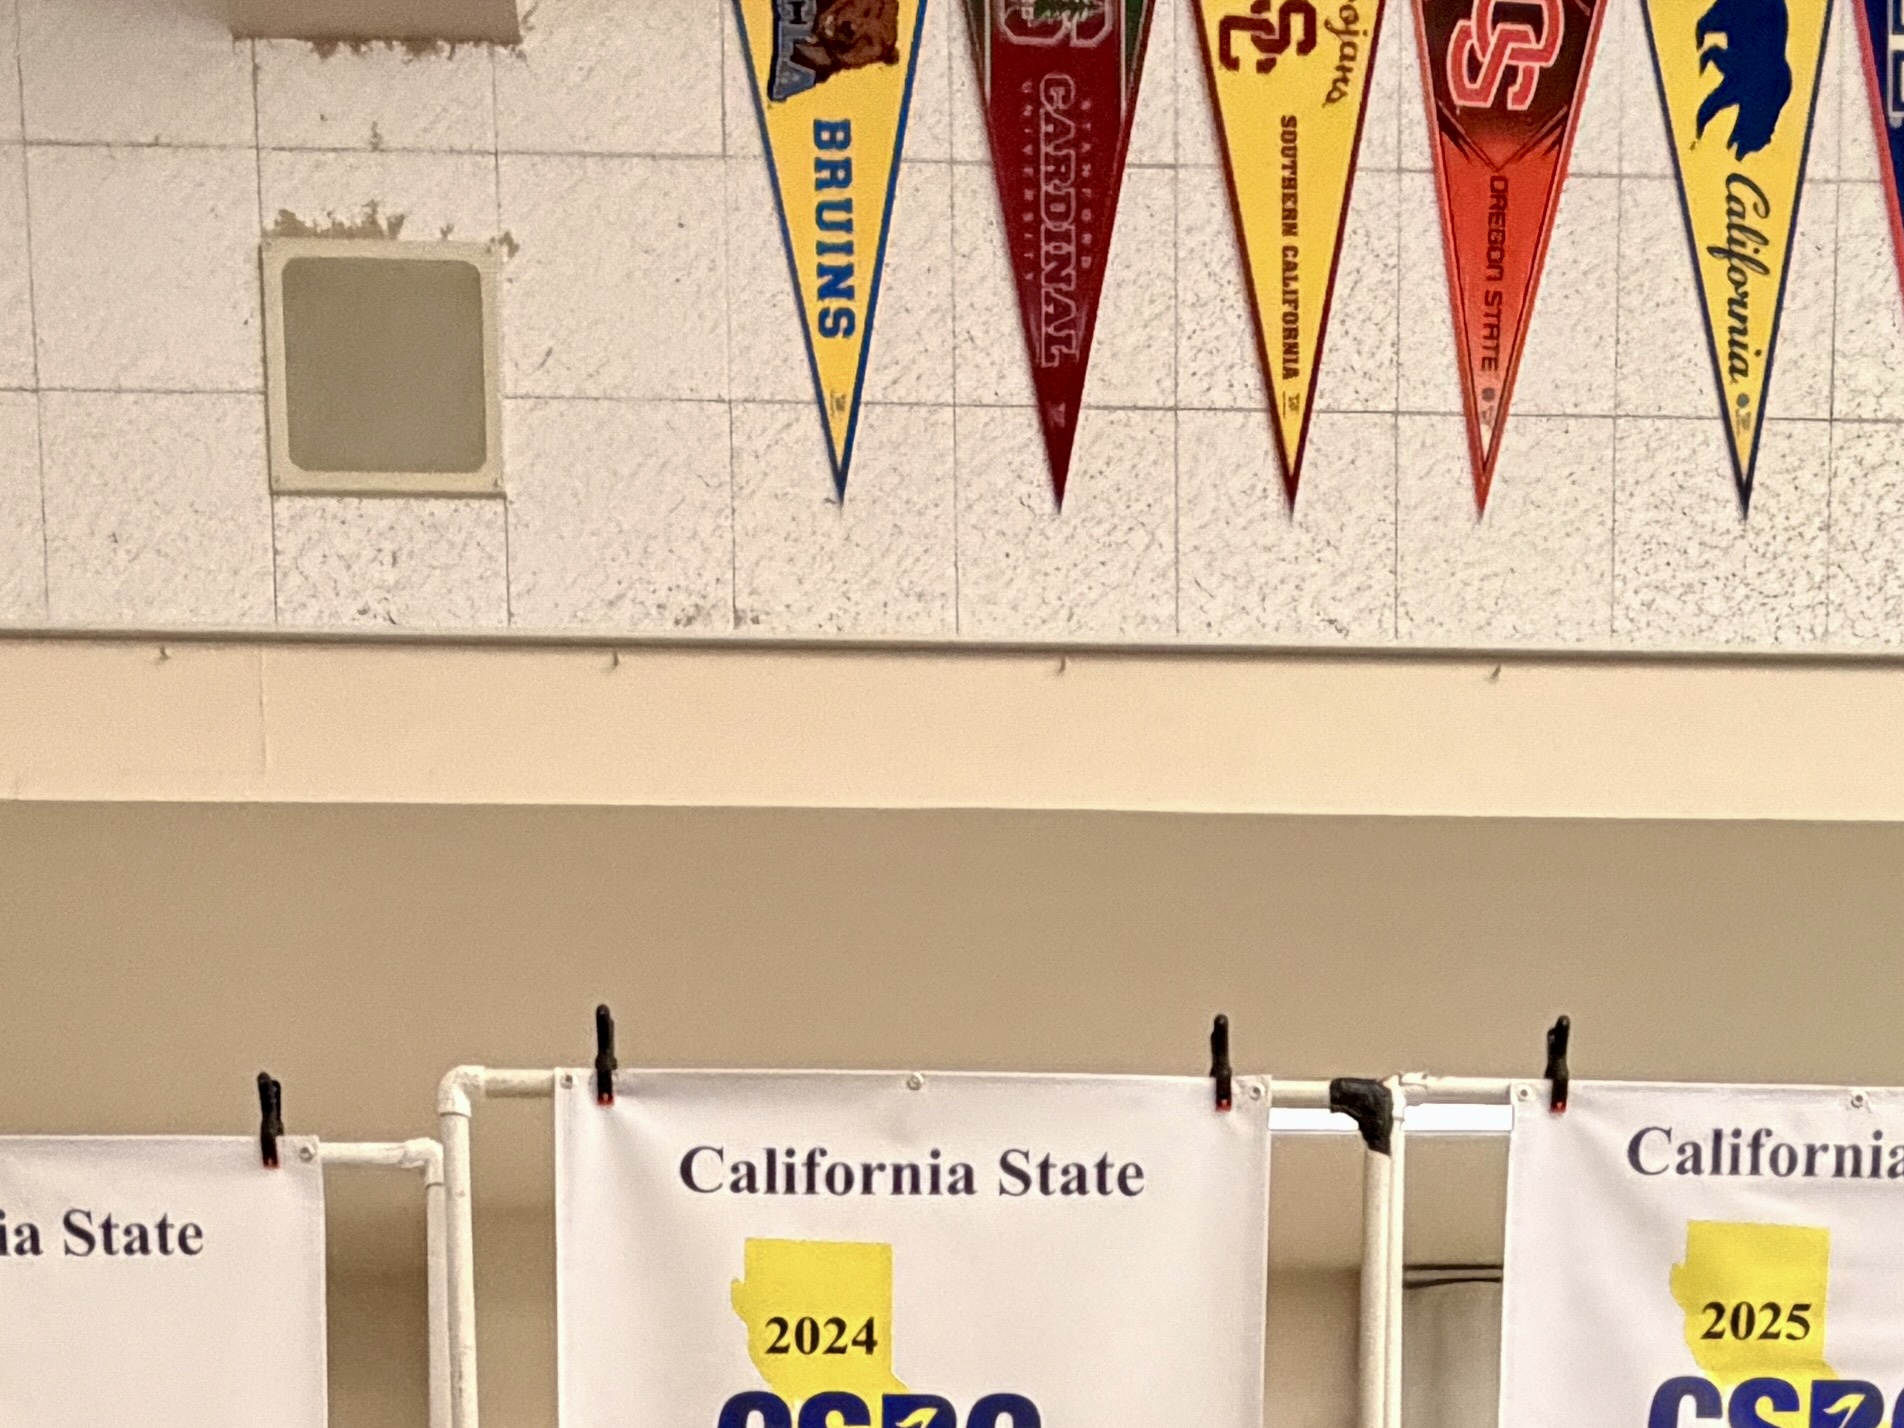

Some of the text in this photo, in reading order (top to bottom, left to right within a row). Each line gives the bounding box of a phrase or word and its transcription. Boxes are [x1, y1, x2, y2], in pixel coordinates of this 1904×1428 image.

[813, 119, 856, 340] BRUINS
[1039, 73, 1077, 368] CARDINAL
[1280, 113, 1301, 380] SOUTHERN CALIFORNIA
[1480, 174, 1510, 372] OREGON STATE
[1704, 172, 1772, 383] California
[62, 1208, 205, 1258] State
[678, 1145, 1146, 1199] California State
[764, 1315, 879, 1357] 2024
[1700, 1299, 1814, 1342] 2025
